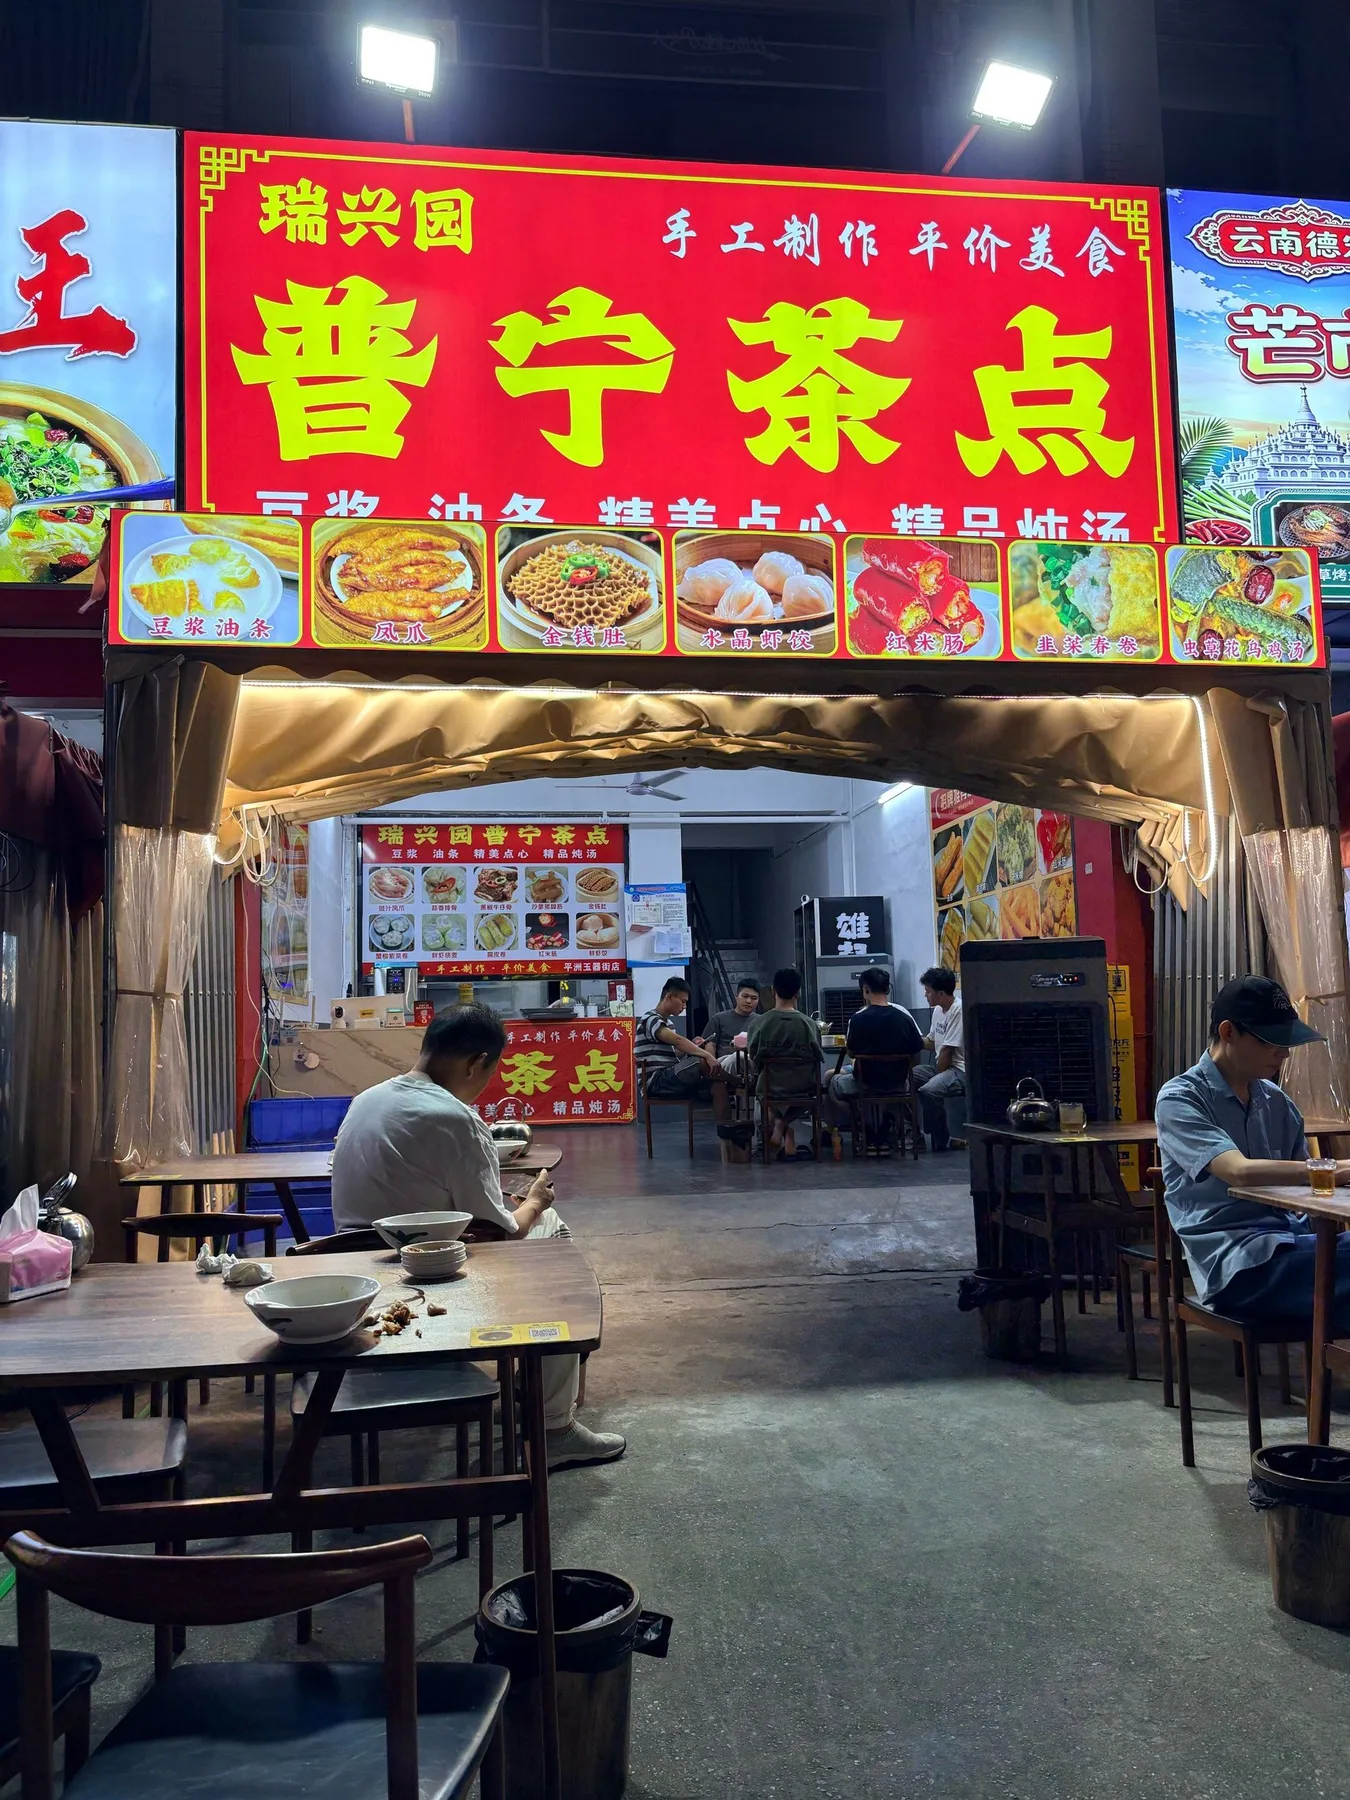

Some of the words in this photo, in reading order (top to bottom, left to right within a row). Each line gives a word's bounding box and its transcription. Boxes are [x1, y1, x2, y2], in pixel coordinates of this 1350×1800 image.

[258, 177, 475, 255] 瑞兴园
[662, 207, 879, 267] 手工制作
[909, 221, 1126, 278] 平价美食
[230, 274, 1135, 479] 普宁茶点
[1319, 568, 1350, 582] 草烤
[149, 616, 274, 639] 豆浆油条
[371, 620, 431, 644] 凤爪
[540, 625, 627, 647] 金钱肚
[700, 628, 814, 650] 水晶虾饺
[886, 631, 965, 653] 红米肠
[1035, 635, 1140, 655] 韭菜春卷
[1183, 638, 1305, 661] 虫草花乌鸡汤
[378, 825, 610, 846] 瑞兴园普宁茶点
[391, 848, 418, 859] 豆浆
[432, 848, 459, 859] 油条
[473, 848, 529, 859] 精美点心
[542, 848, 597, 859] 精品炖汤
[436, 963, 486, 974] 手工制作
[501, 962, 551, 974] 平价美食
[563, 962, 620, 972] 平洲玉器街店
[506, 1030, 561, 1045] 手工制作
[567, 1025, 625, 1043] 平价美食
[500, 1048, 625, 1096] 茶点
[553, 1099, 622, 1117] 精品炖汤
